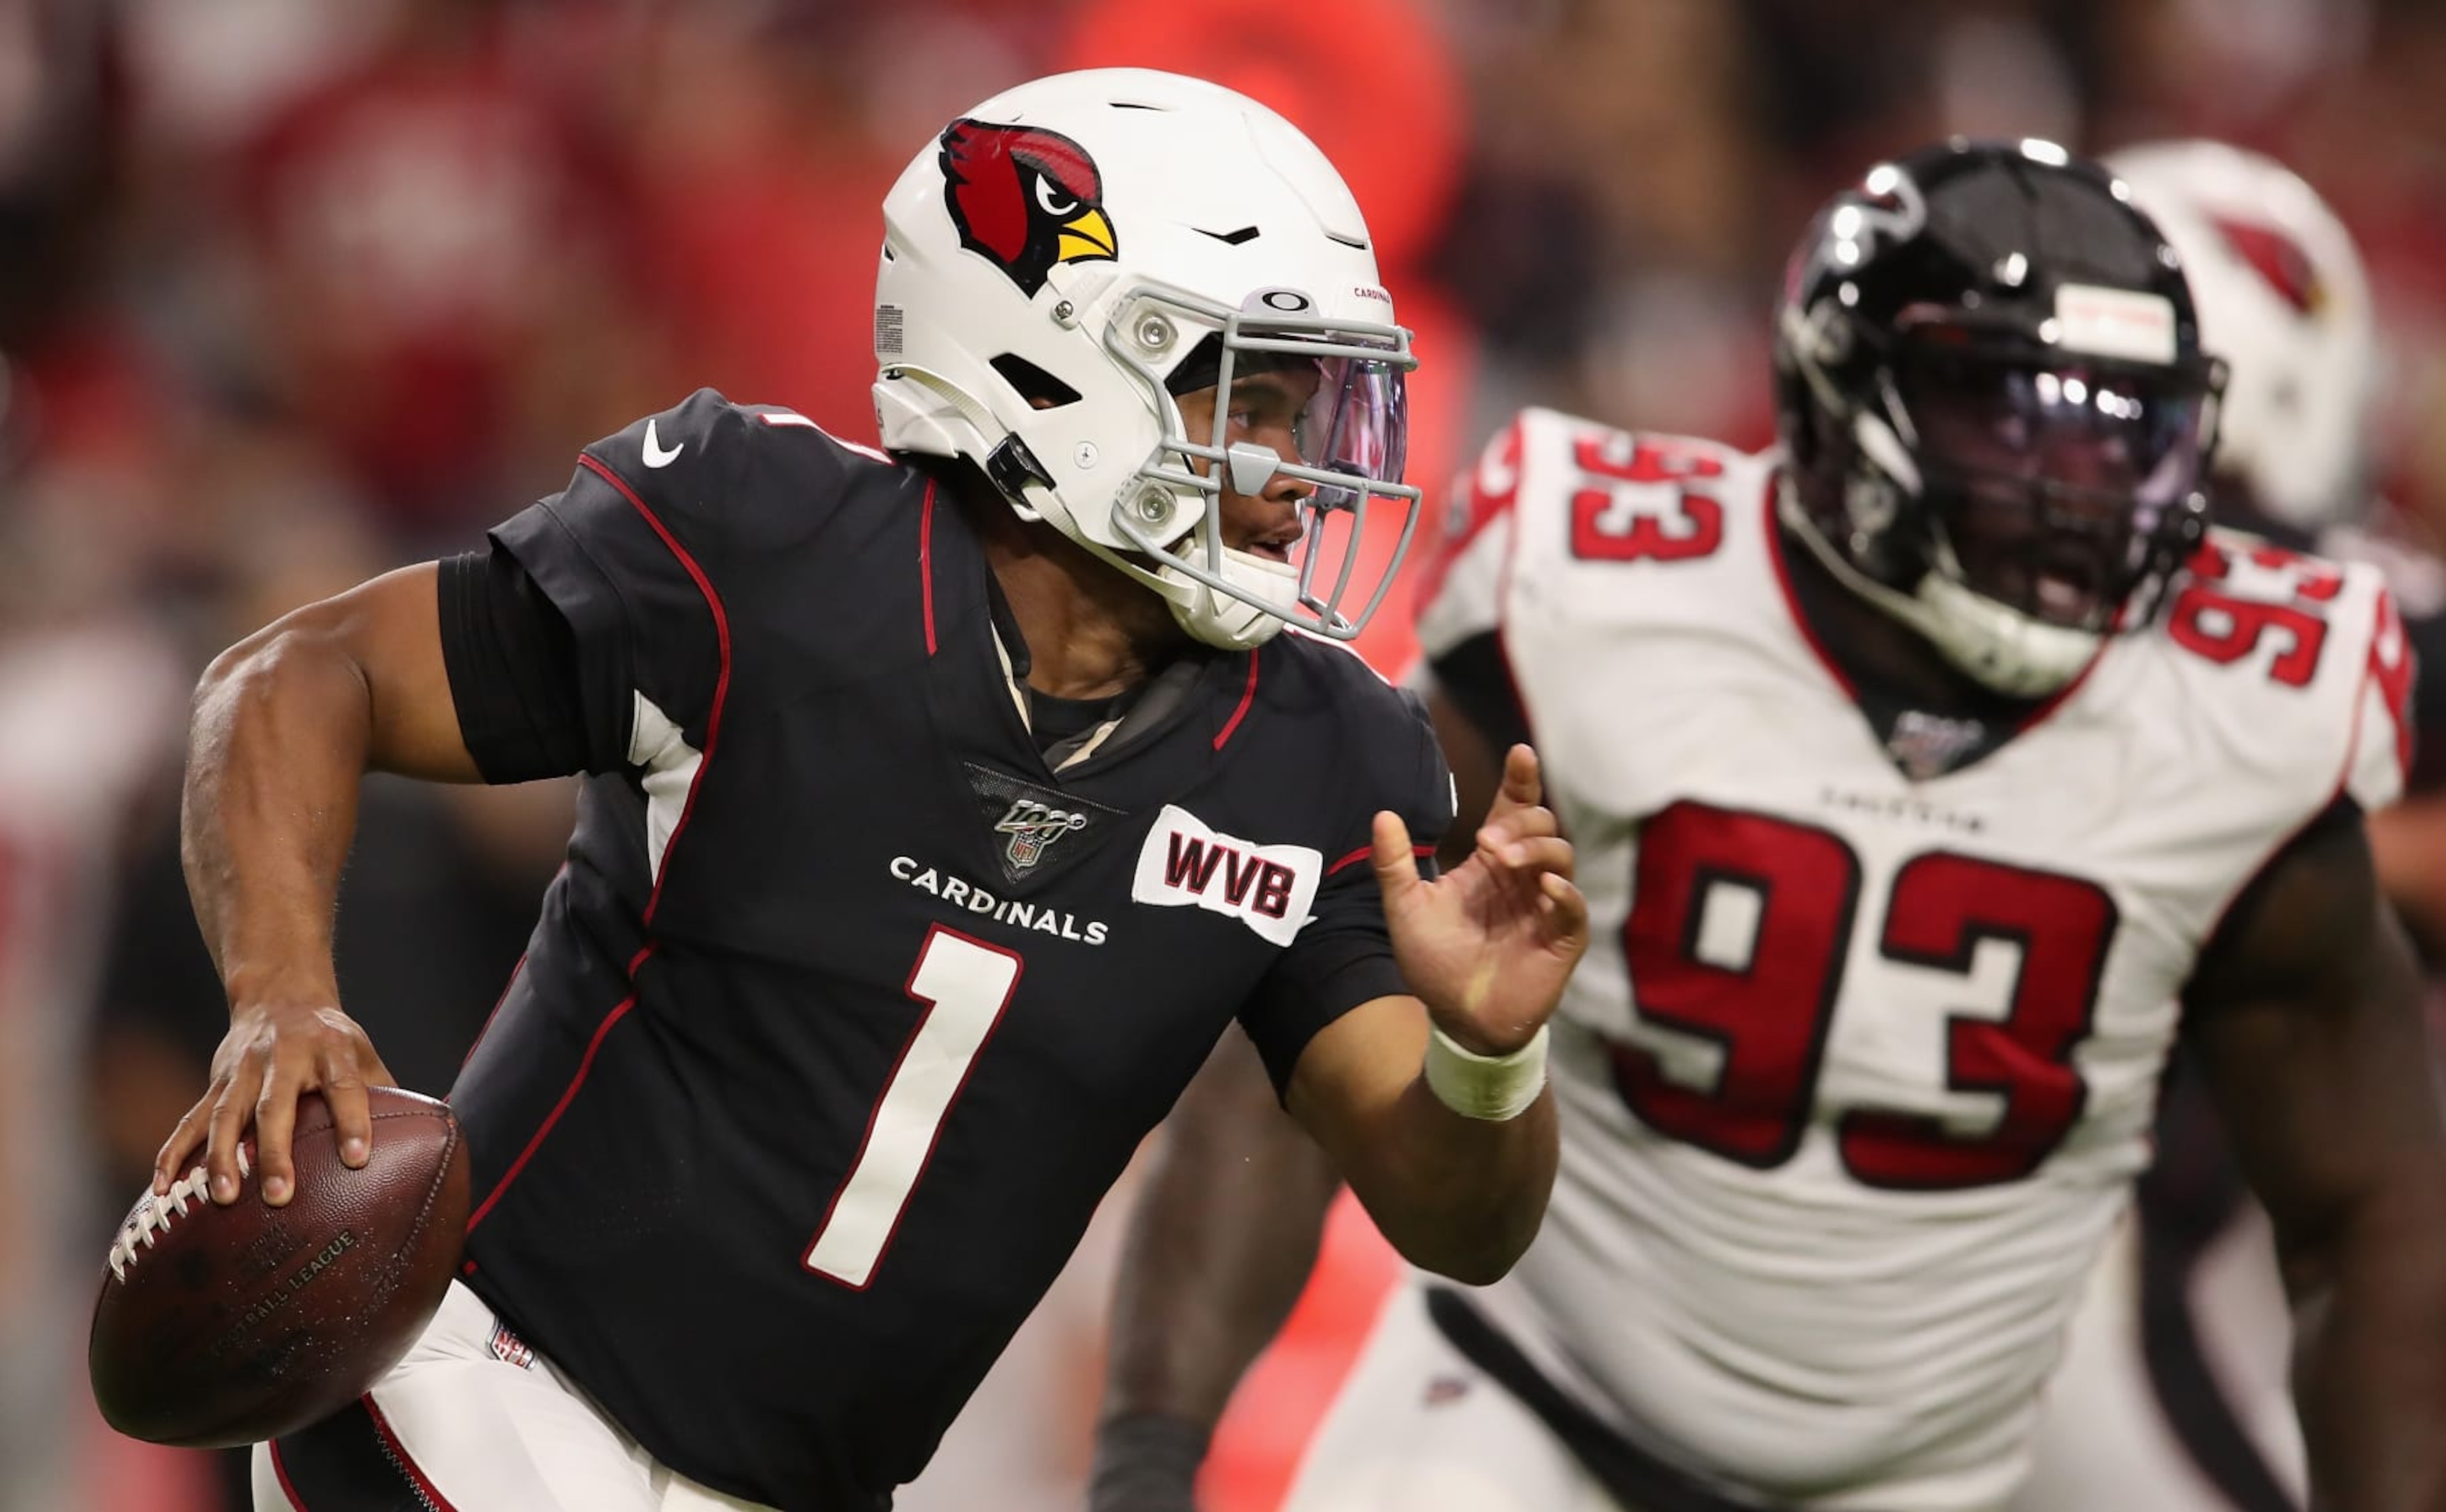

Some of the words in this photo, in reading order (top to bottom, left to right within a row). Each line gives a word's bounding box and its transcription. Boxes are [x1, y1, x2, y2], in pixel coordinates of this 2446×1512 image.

[890, 856, 1108, 945] CARDINALS
[1164, 831, 1296, 919] WVB
[1601, 797, 2120, 1192] 93
[800, 922, 1024, 1292] 1
[289, 1230, 356, 1290] LEAGUE
